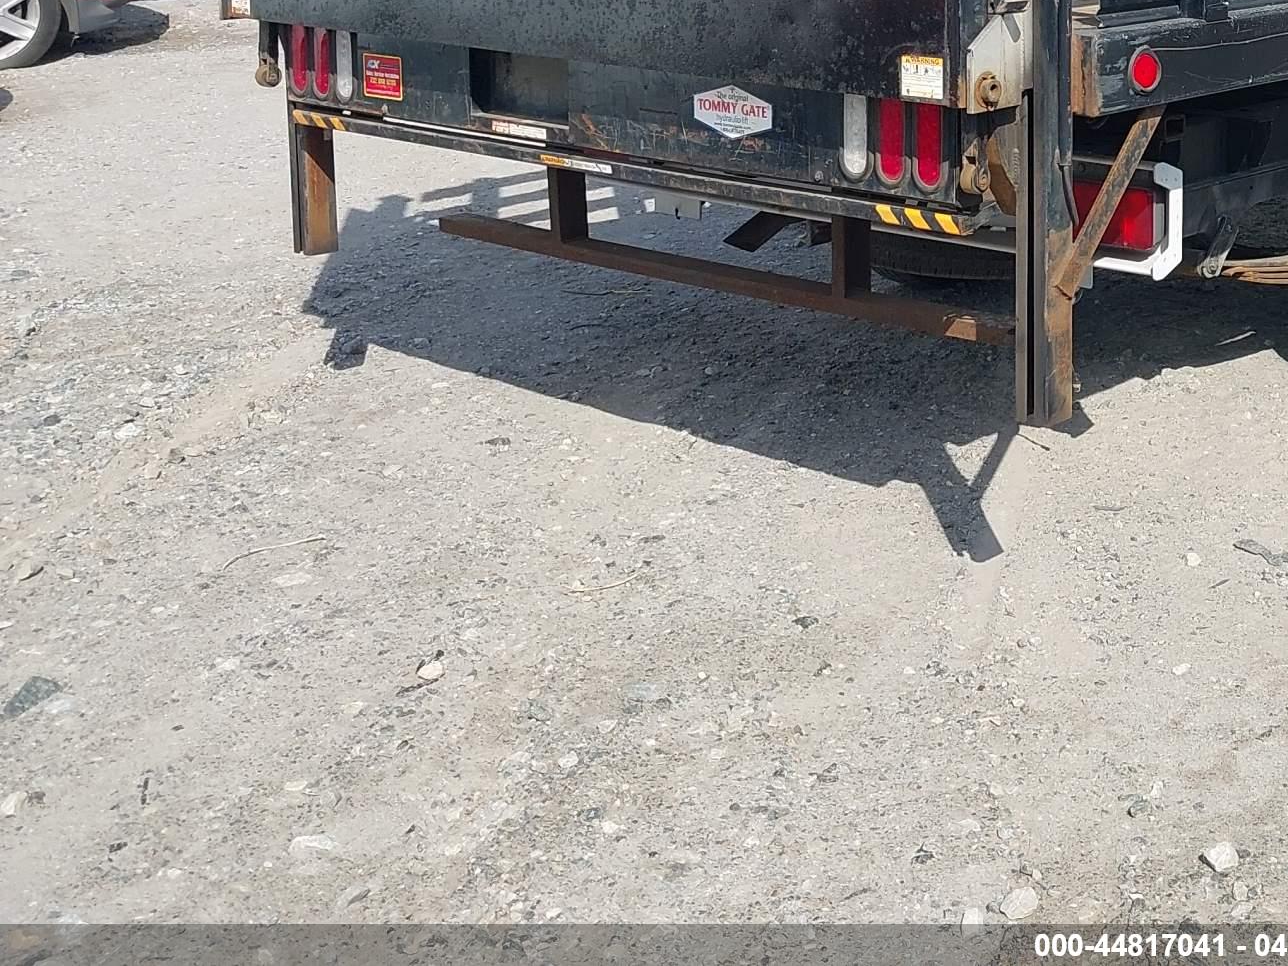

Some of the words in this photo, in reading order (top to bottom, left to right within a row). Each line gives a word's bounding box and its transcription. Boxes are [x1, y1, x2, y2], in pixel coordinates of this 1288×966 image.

[911, 56, 940, 65] WARNING
[716, 91, 727, 100] The
[728, 92, 749, 102] original
[697, 99, 737, 114] TOMMY
[741, 104, 768, 118] GATE
